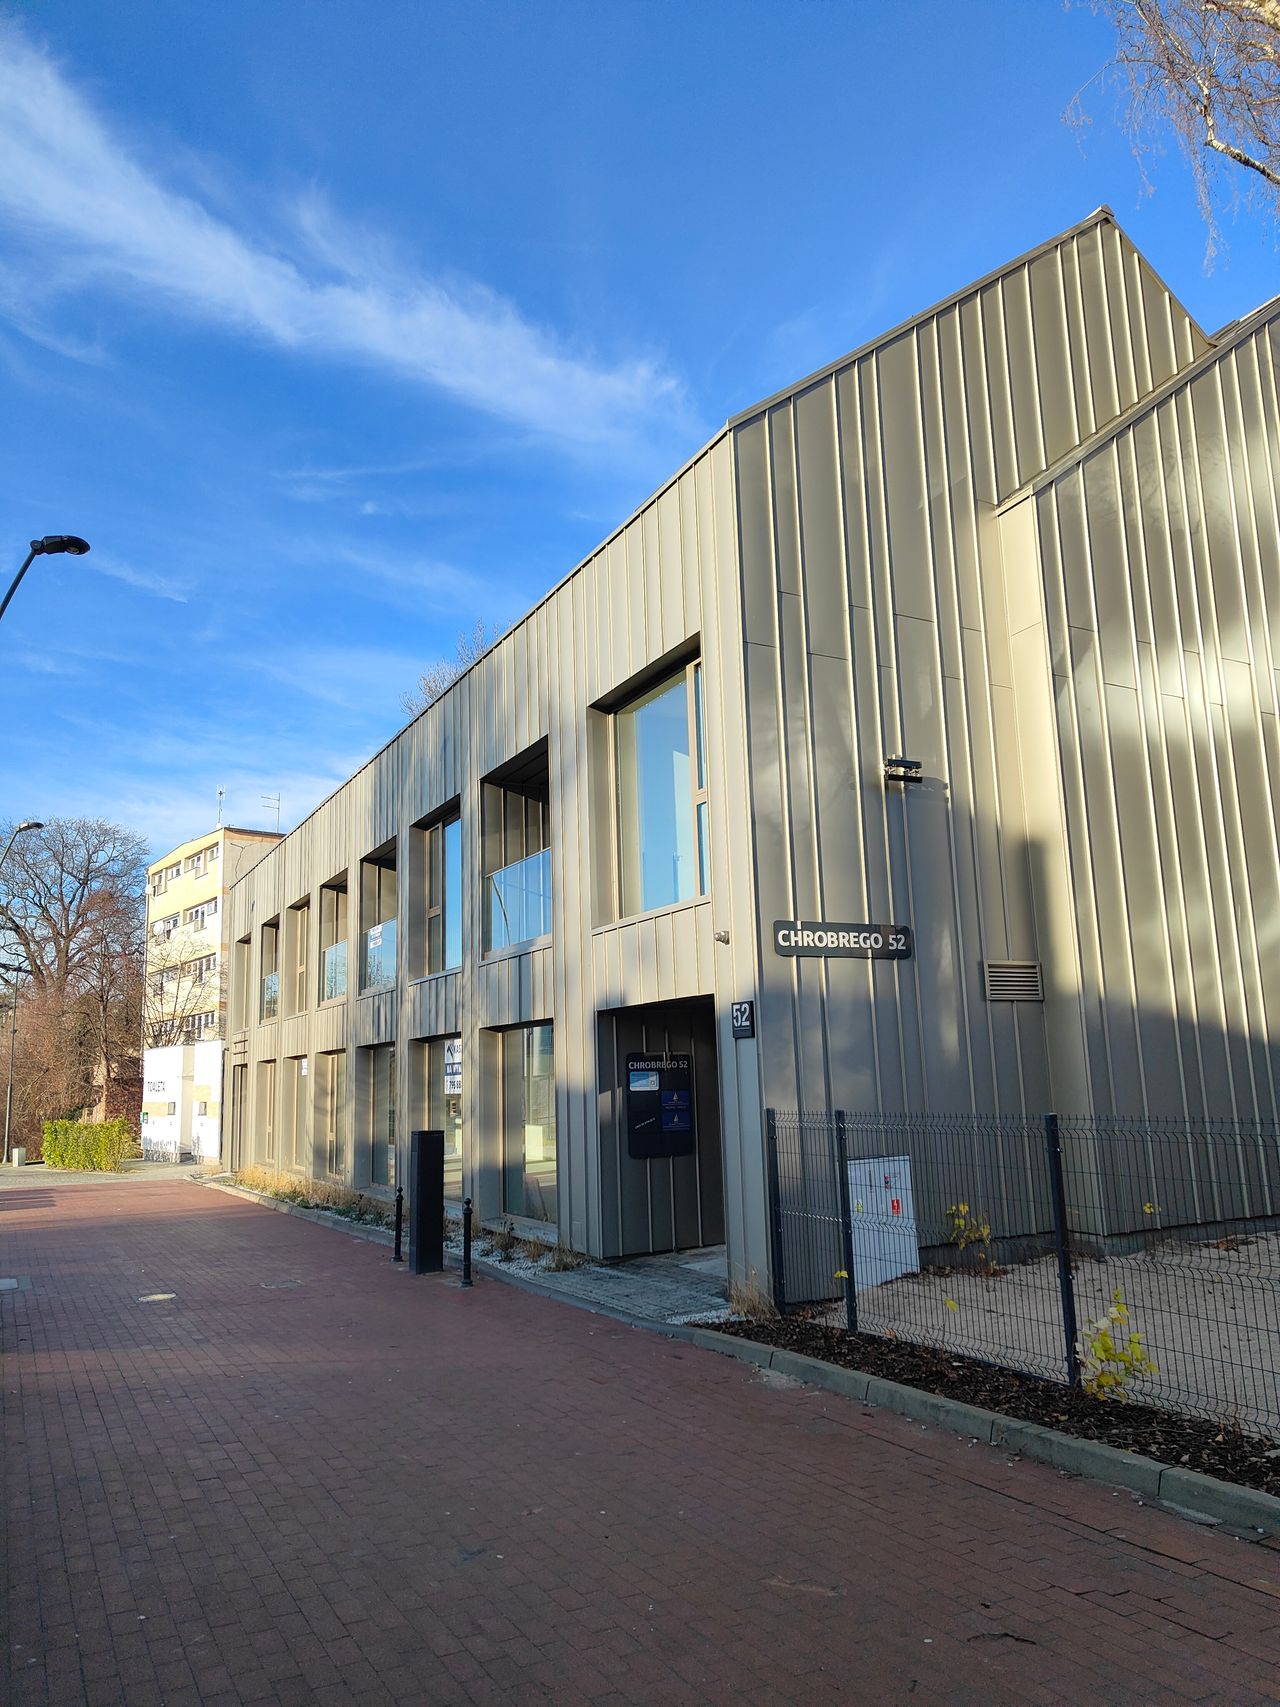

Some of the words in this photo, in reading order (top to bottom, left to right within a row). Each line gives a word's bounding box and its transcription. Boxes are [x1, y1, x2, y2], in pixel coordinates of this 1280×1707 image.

[777, 929, 883, 949] CHROBREGO
[888, 934, 906, 950] 52
[733, 1003, 750, 1027] 52
[628, 1060, 678, 1070] CHROBREGO
[679, 1060, 688, 1069] 52
[147, 1081, 165, 1092] TOALETA
